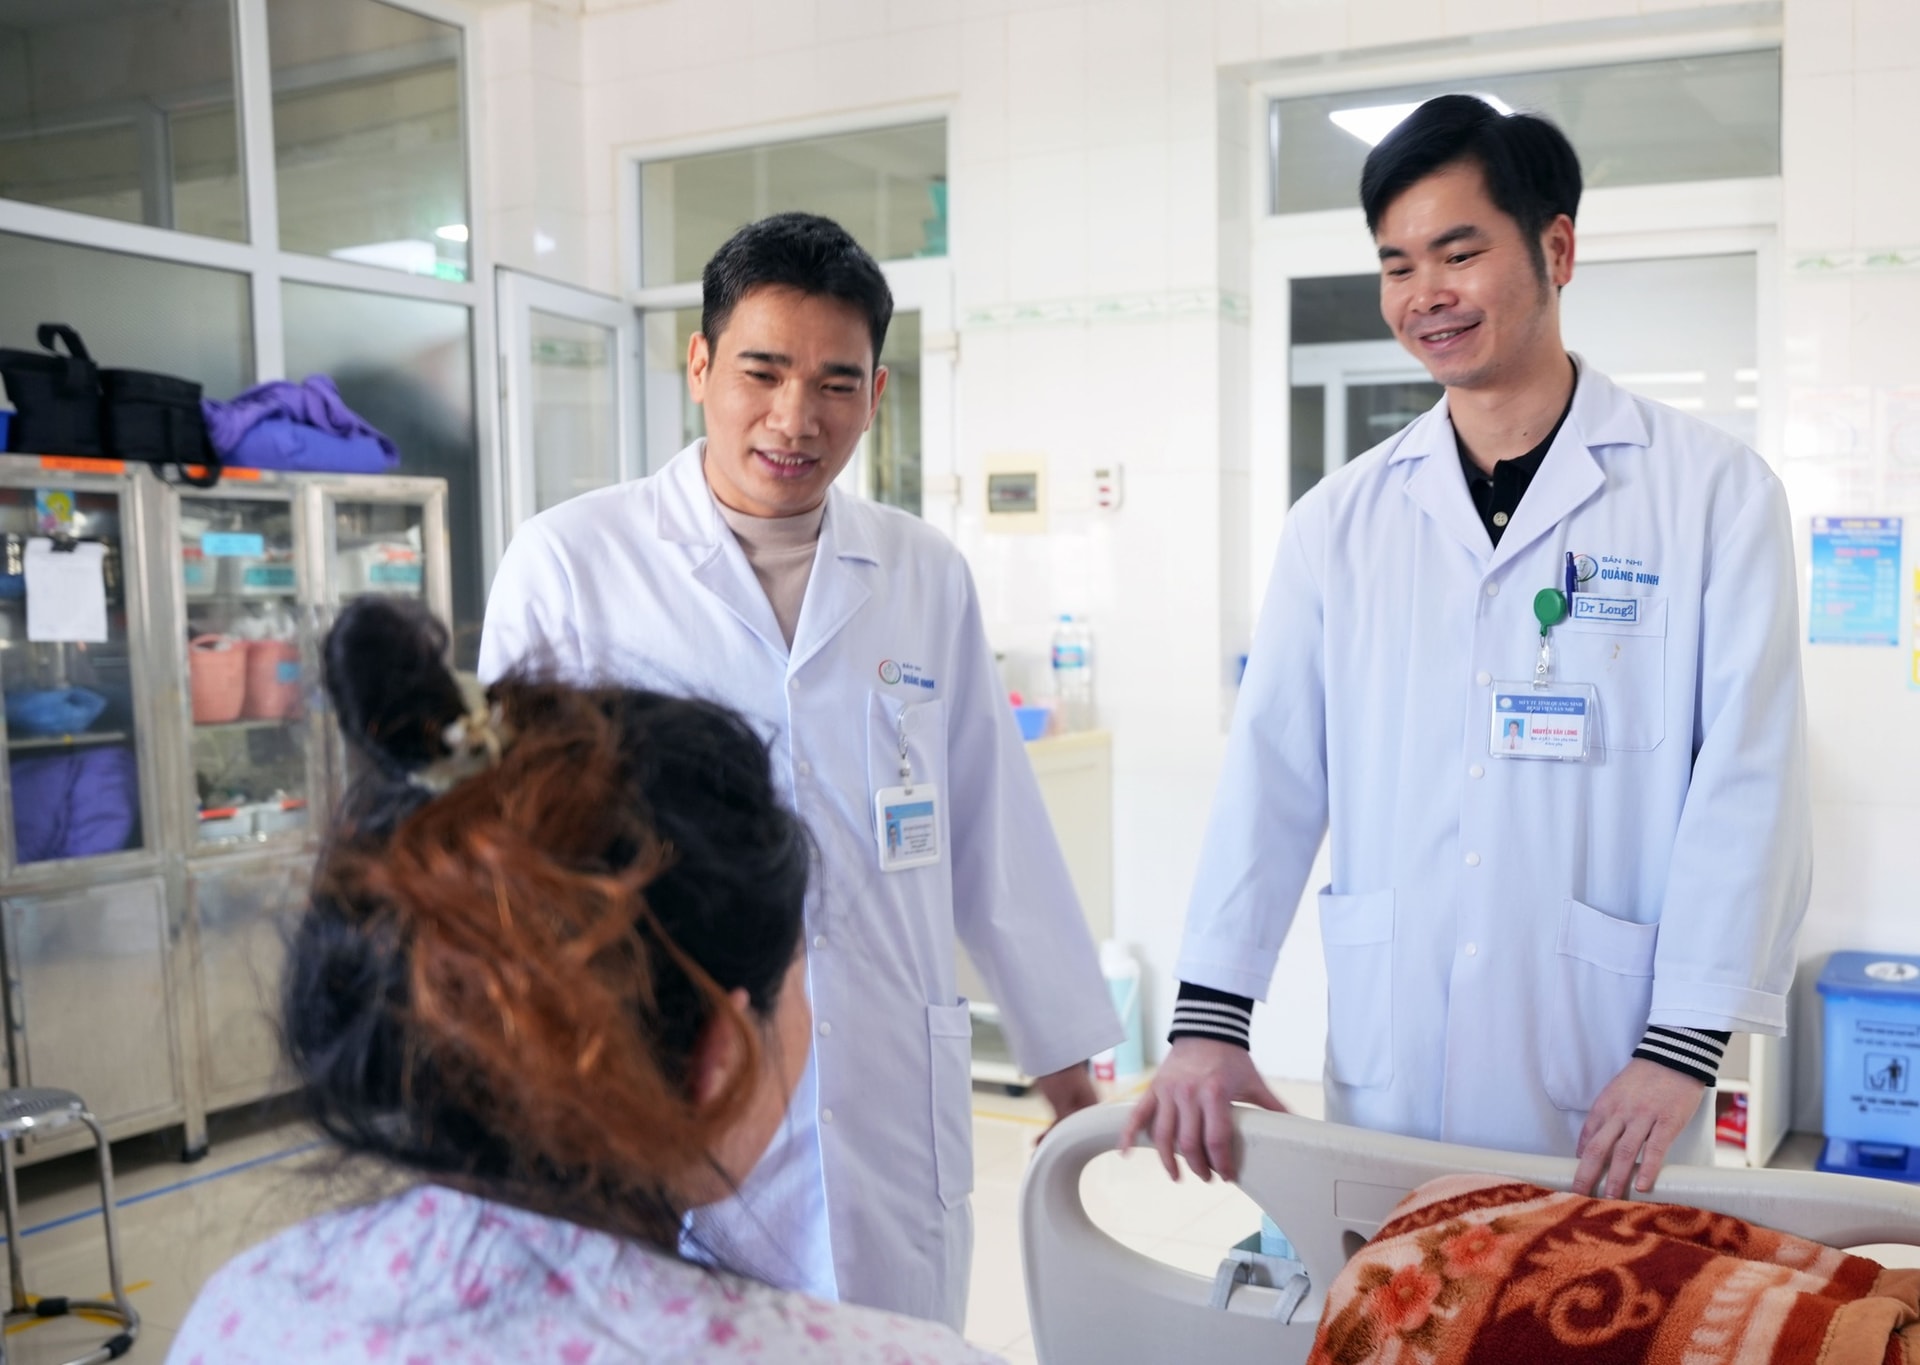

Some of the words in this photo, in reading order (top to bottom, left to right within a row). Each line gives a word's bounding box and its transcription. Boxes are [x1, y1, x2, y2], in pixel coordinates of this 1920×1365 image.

[1601, 567, 1633, 582] QUẢNG
[1636, 573, 1659, 585] NINH
[1580, 601, 1595, 613] Dr
[1599, 603, 1634, 617] Long2
